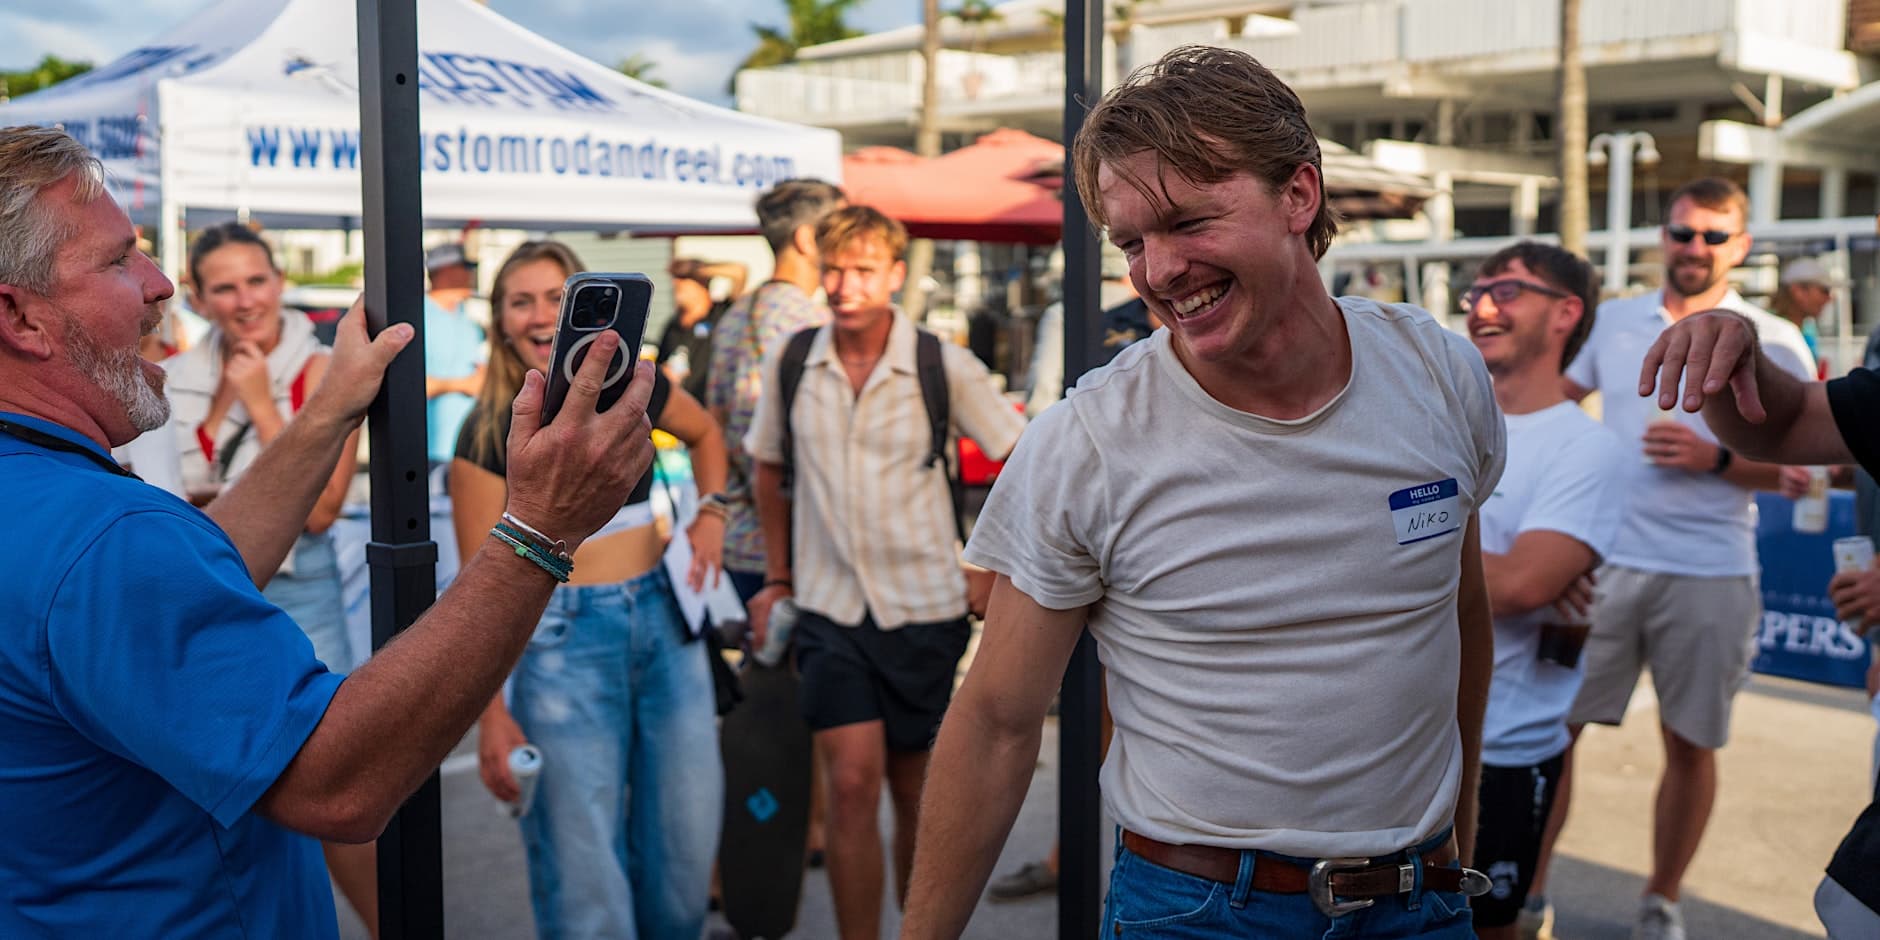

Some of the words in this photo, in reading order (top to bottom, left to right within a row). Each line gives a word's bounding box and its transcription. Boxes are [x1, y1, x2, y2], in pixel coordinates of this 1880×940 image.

[419, 52, 617, 104] USTOM
[1409, 484, 1440, 499] HELLO
[1759, 609, 1866, 660] PERS
